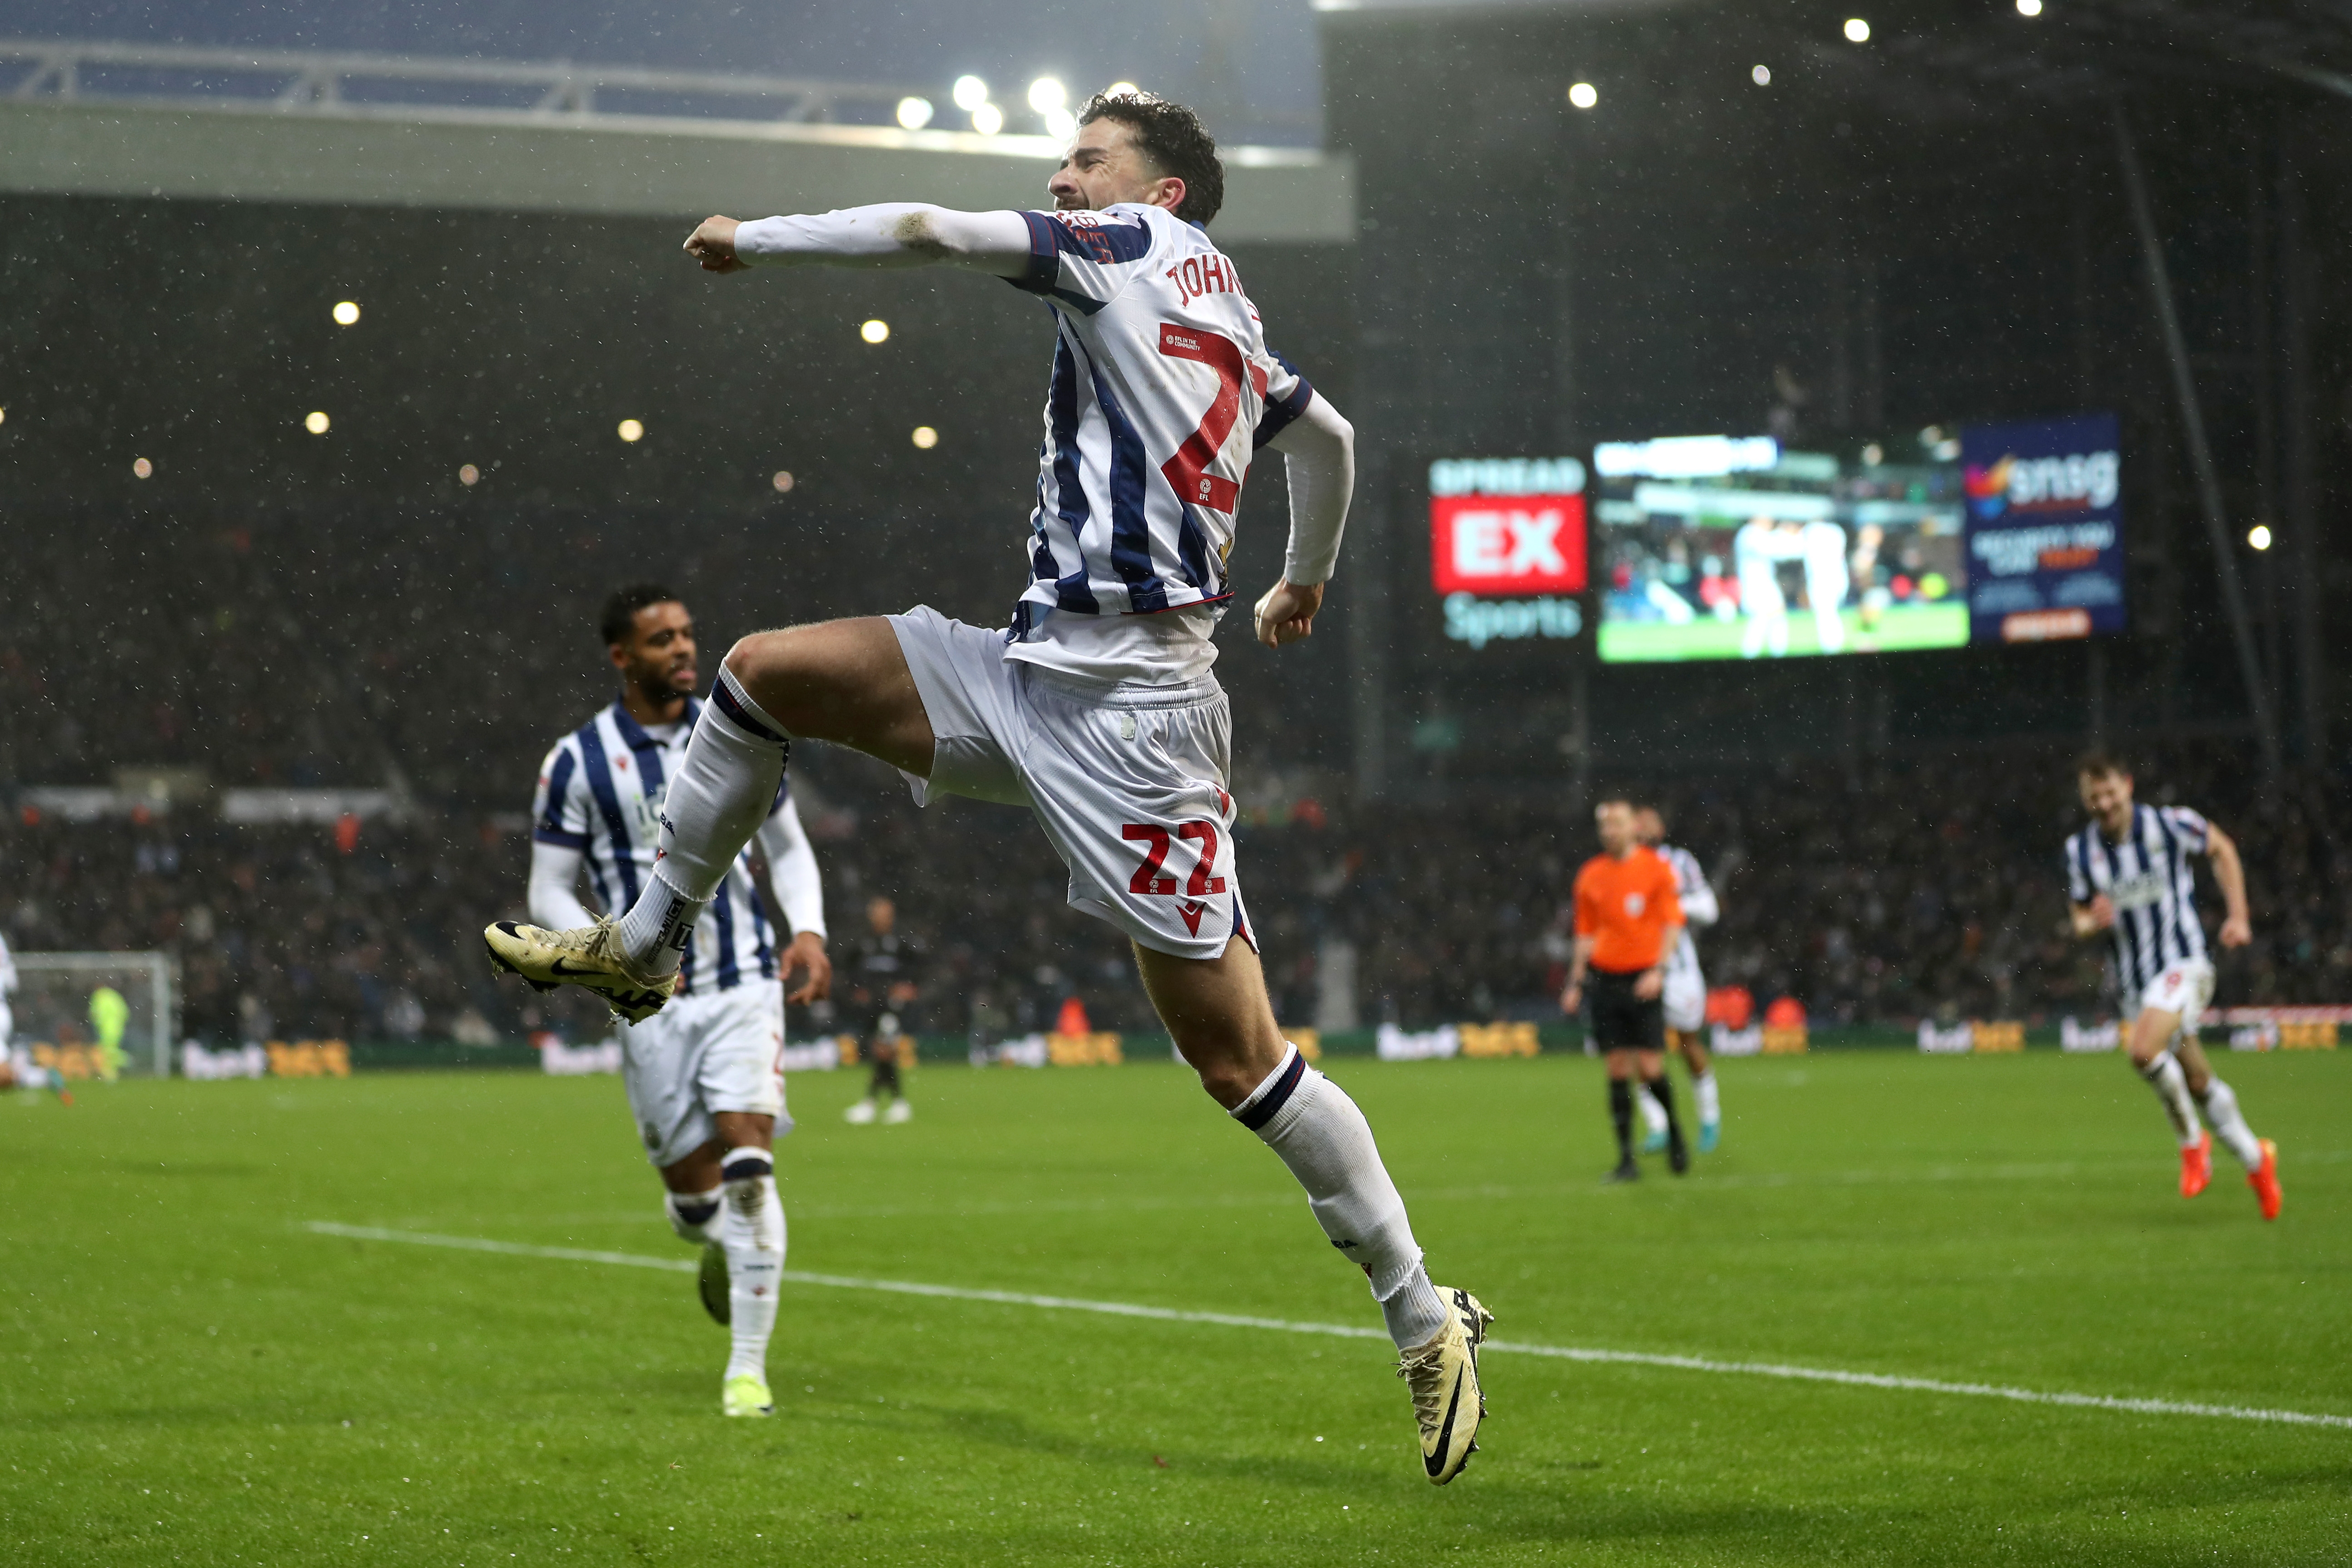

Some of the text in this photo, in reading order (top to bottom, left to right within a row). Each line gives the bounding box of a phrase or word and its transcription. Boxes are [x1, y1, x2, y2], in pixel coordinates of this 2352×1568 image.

[1174, 341, 1201, 351] COMMUNITY
[1199, 493, 1209, 502] EFL
[1453, 510, 1565, 576] EX
[1444, 592, 1581, 649] Sports
[1122, 820, 1226, 896] 22
